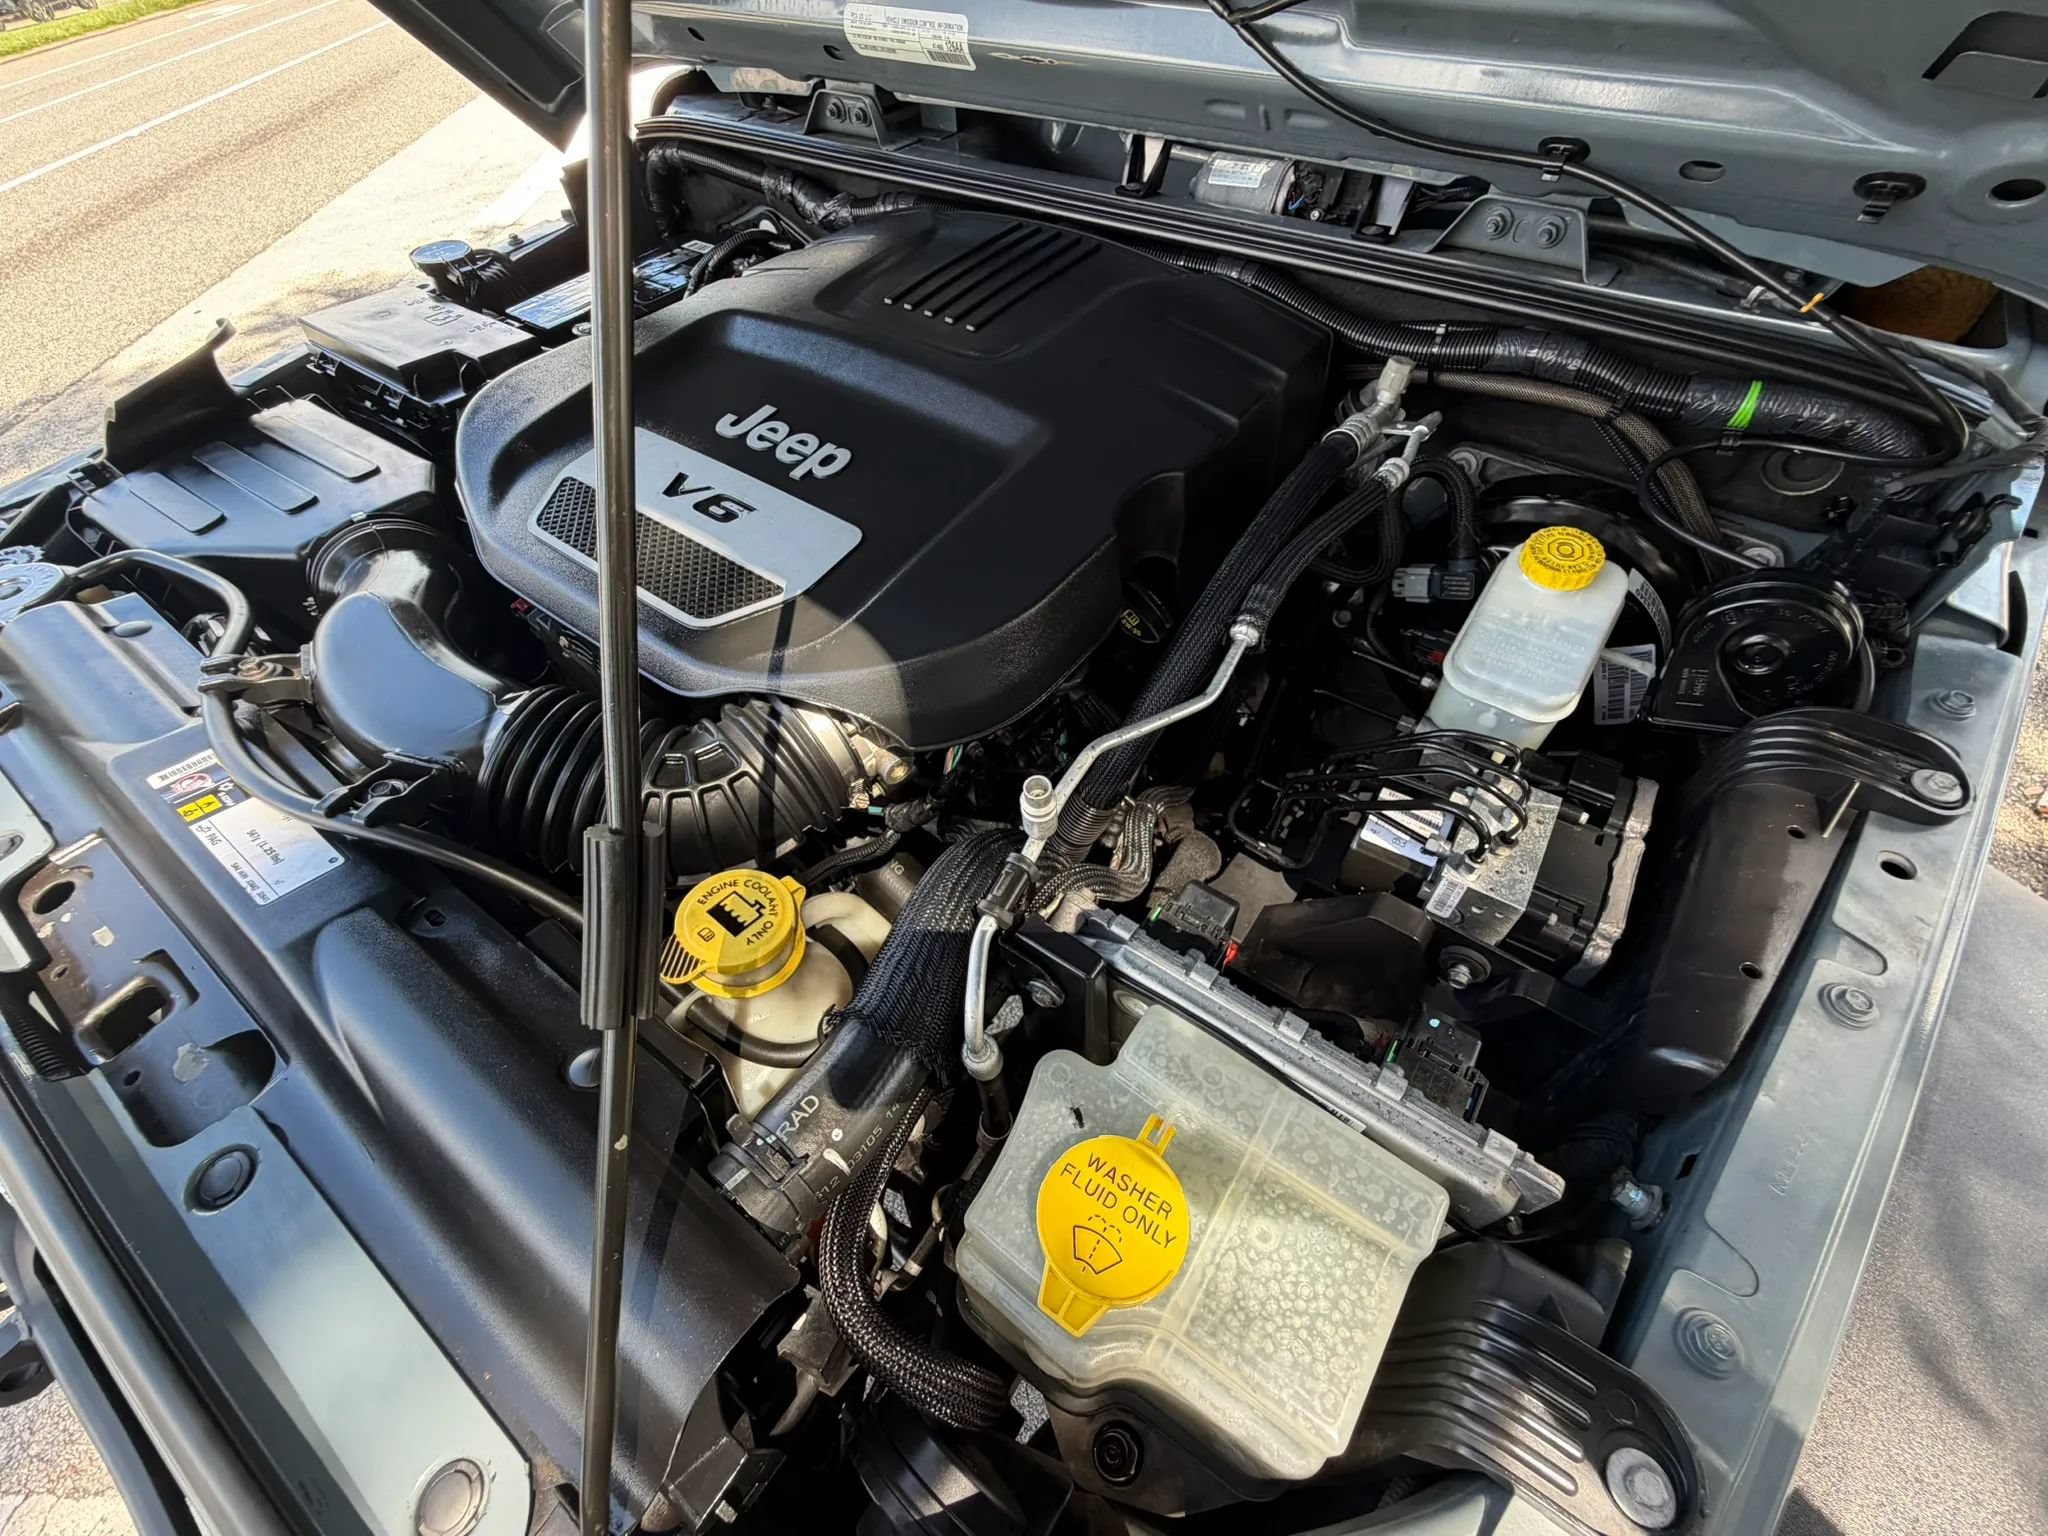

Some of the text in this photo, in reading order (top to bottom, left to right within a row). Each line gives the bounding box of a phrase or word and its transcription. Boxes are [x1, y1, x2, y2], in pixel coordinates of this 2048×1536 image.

[900, 18, 918, 27] EMISSION
[919, 20, 936, 28] CONTROL
[937, 21, 964, 31] INFORMATION
[715, 404, 852, 481] Jeep
[662, 472, 759, 523] V6
[207, 832, 222, 846] PAG
[697, 879, 779, 946] ENGINE COOLANT ONLY
[776, 1095, 820, 1142] RAD
[1060, 1162, 1177, 1249] FLUID ONLY
[1088, 1152, 1173, 1220] WASHER
